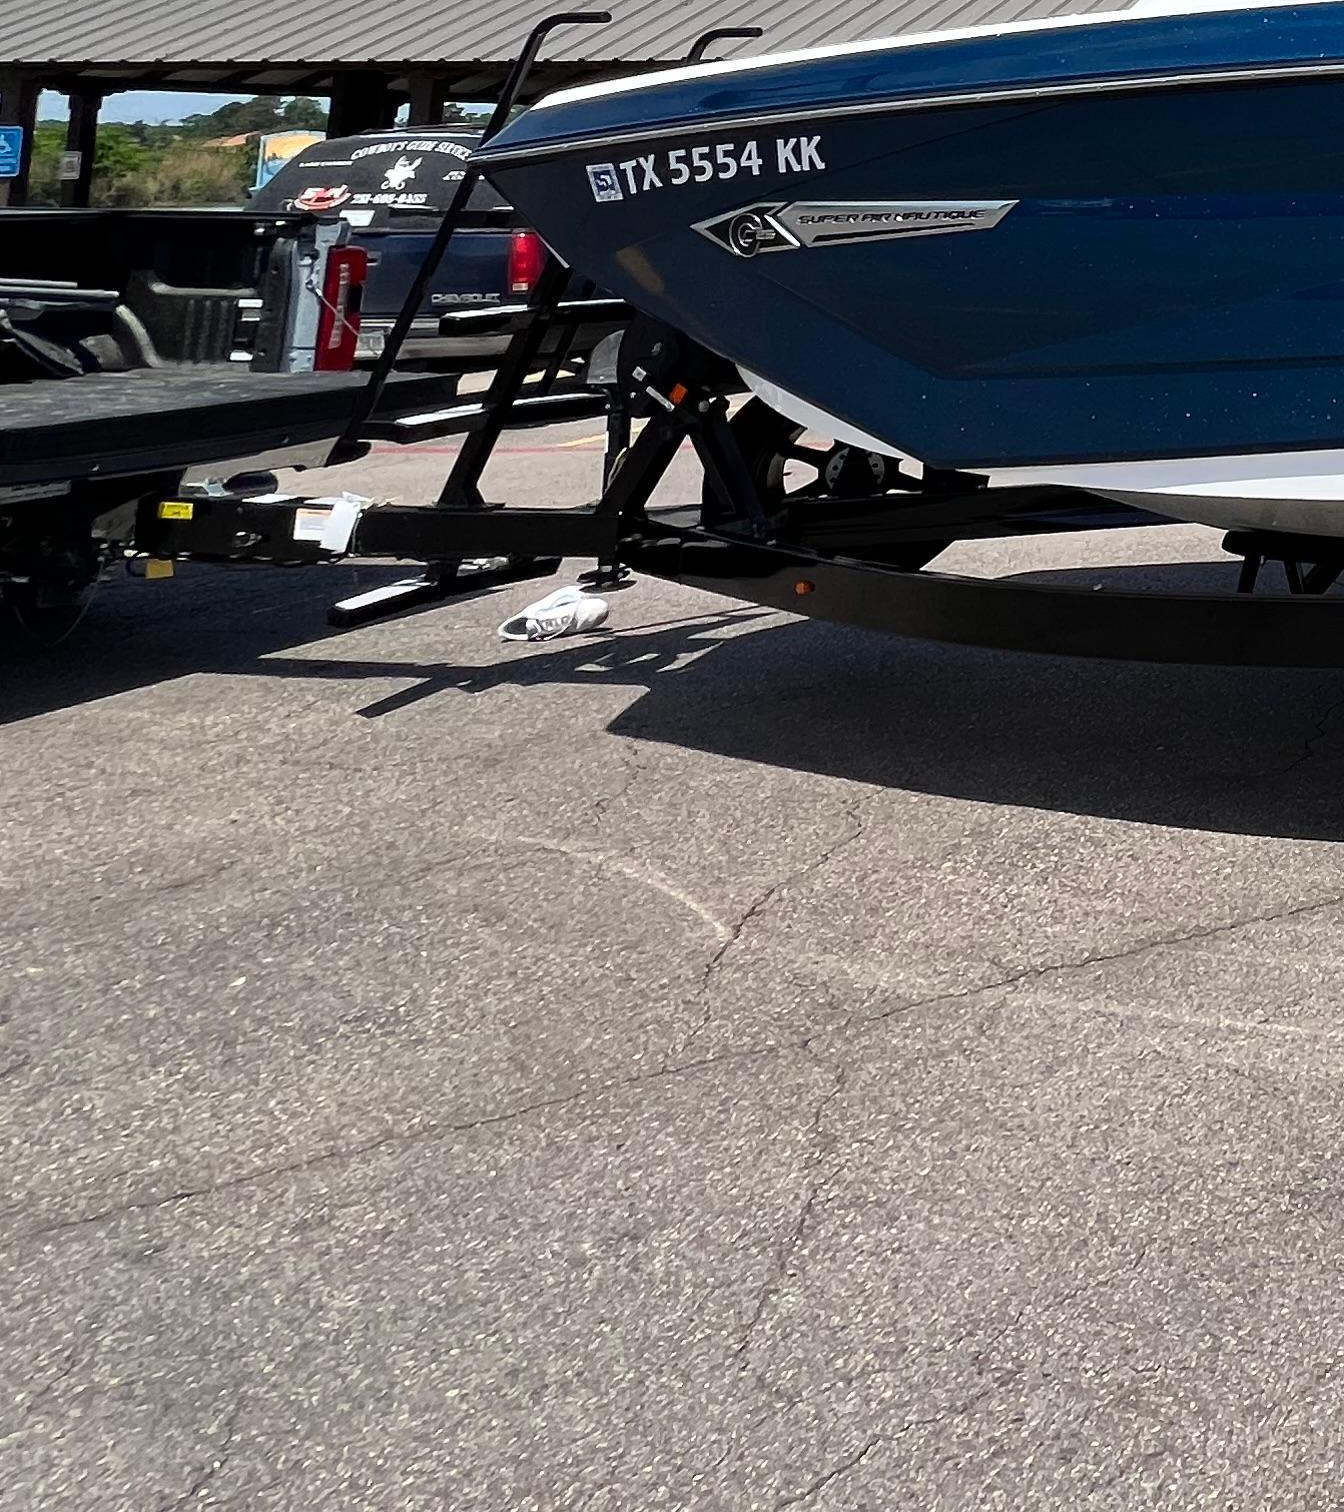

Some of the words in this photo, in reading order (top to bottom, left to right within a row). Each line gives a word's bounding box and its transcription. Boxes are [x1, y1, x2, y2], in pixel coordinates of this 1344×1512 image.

[619, 154, 663, 194] TX
[668, 141, 763, 185] 5554
[776, 135, 826, 173] KK
[797, 214, 858, 225] SUPER
[861, 212, 891, 223] AIR
[894, 209, 987, 222] NAUTIQUE
